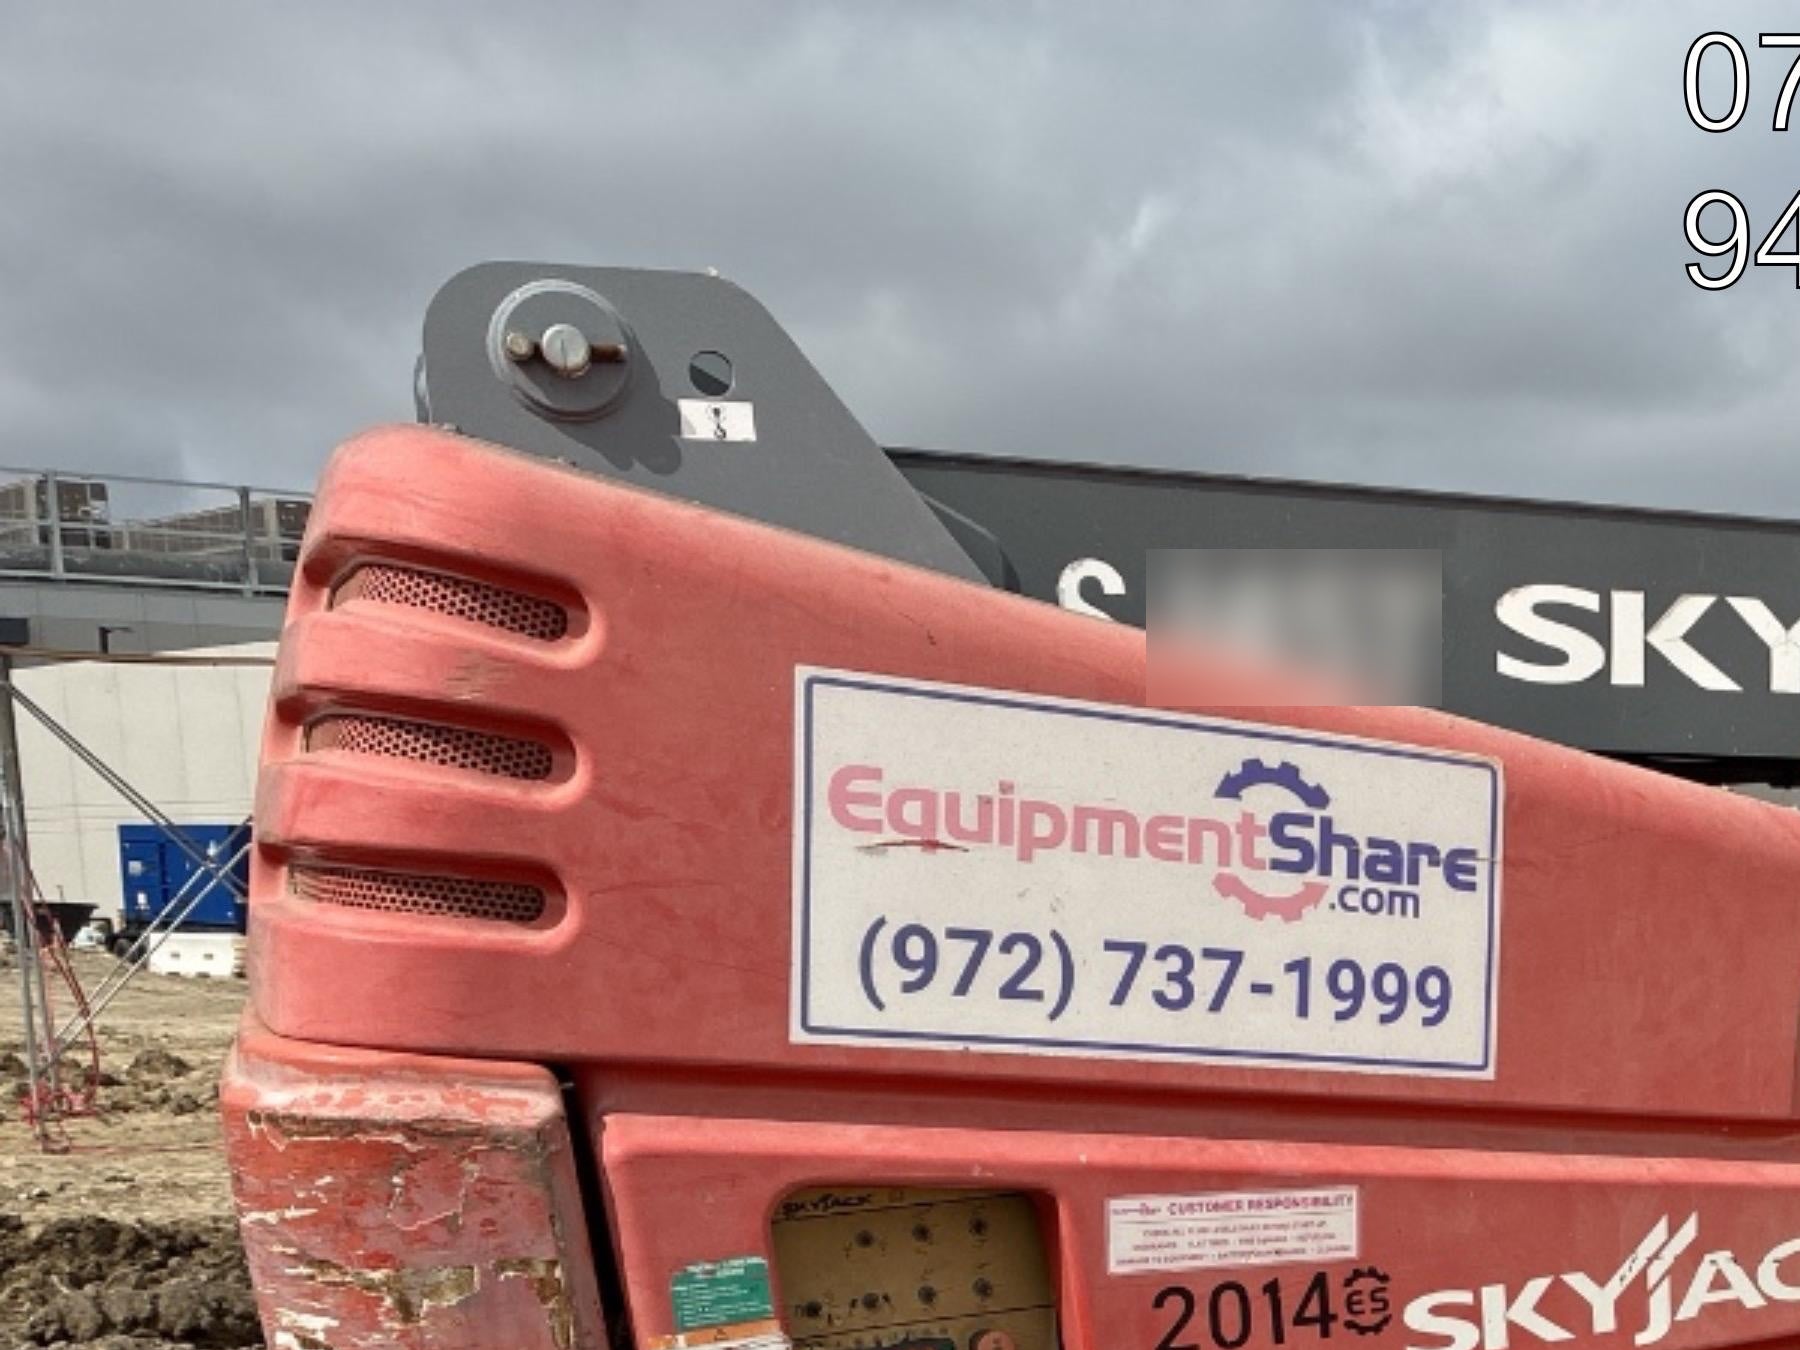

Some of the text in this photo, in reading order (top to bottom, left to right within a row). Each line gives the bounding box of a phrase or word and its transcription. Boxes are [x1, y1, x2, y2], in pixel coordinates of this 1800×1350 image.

[827, 765, 1477, 892] EquipmentShare
[1328, 884, 1420, 919] .com
[858, 916, 1453, 1027] (972) 737-1999
